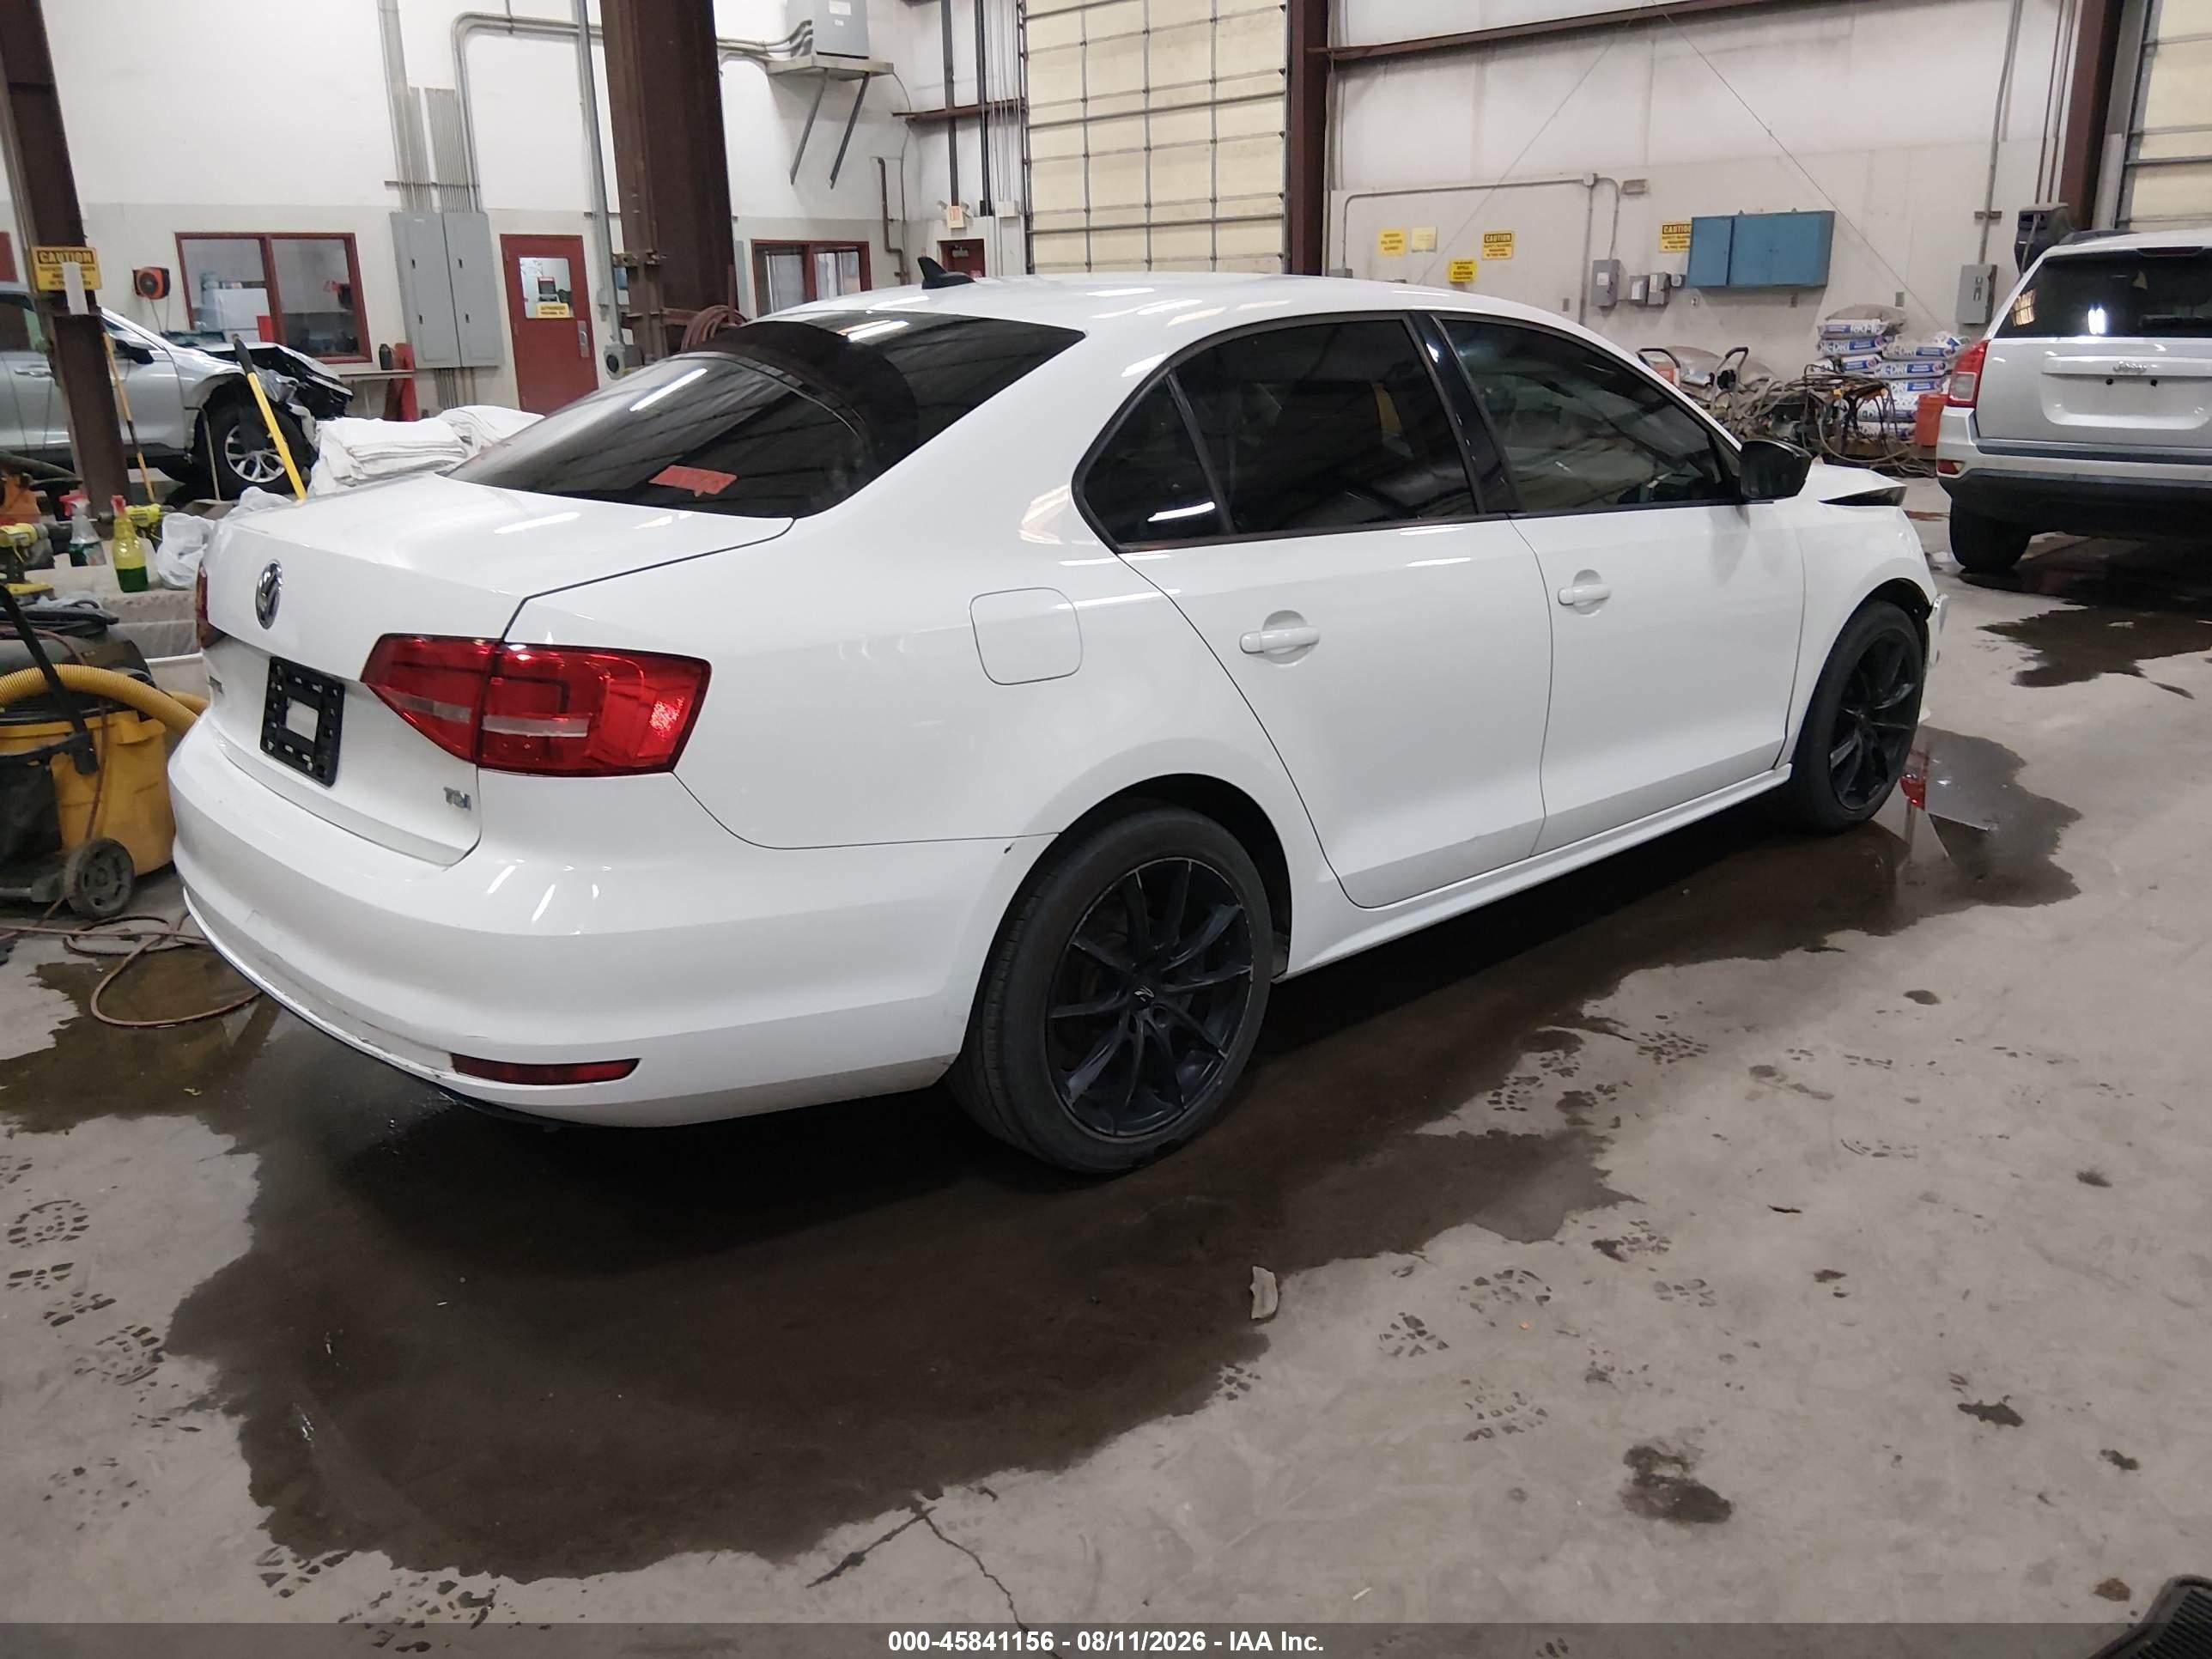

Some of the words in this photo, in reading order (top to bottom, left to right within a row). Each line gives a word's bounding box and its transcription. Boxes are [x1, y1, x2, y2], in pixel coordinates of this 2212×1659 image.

[1663, 225, 1691, 234] CAUTIO
[1486, 234, 1511, 243] CAUTION
[39, 251, 93, 264] CAUTION
